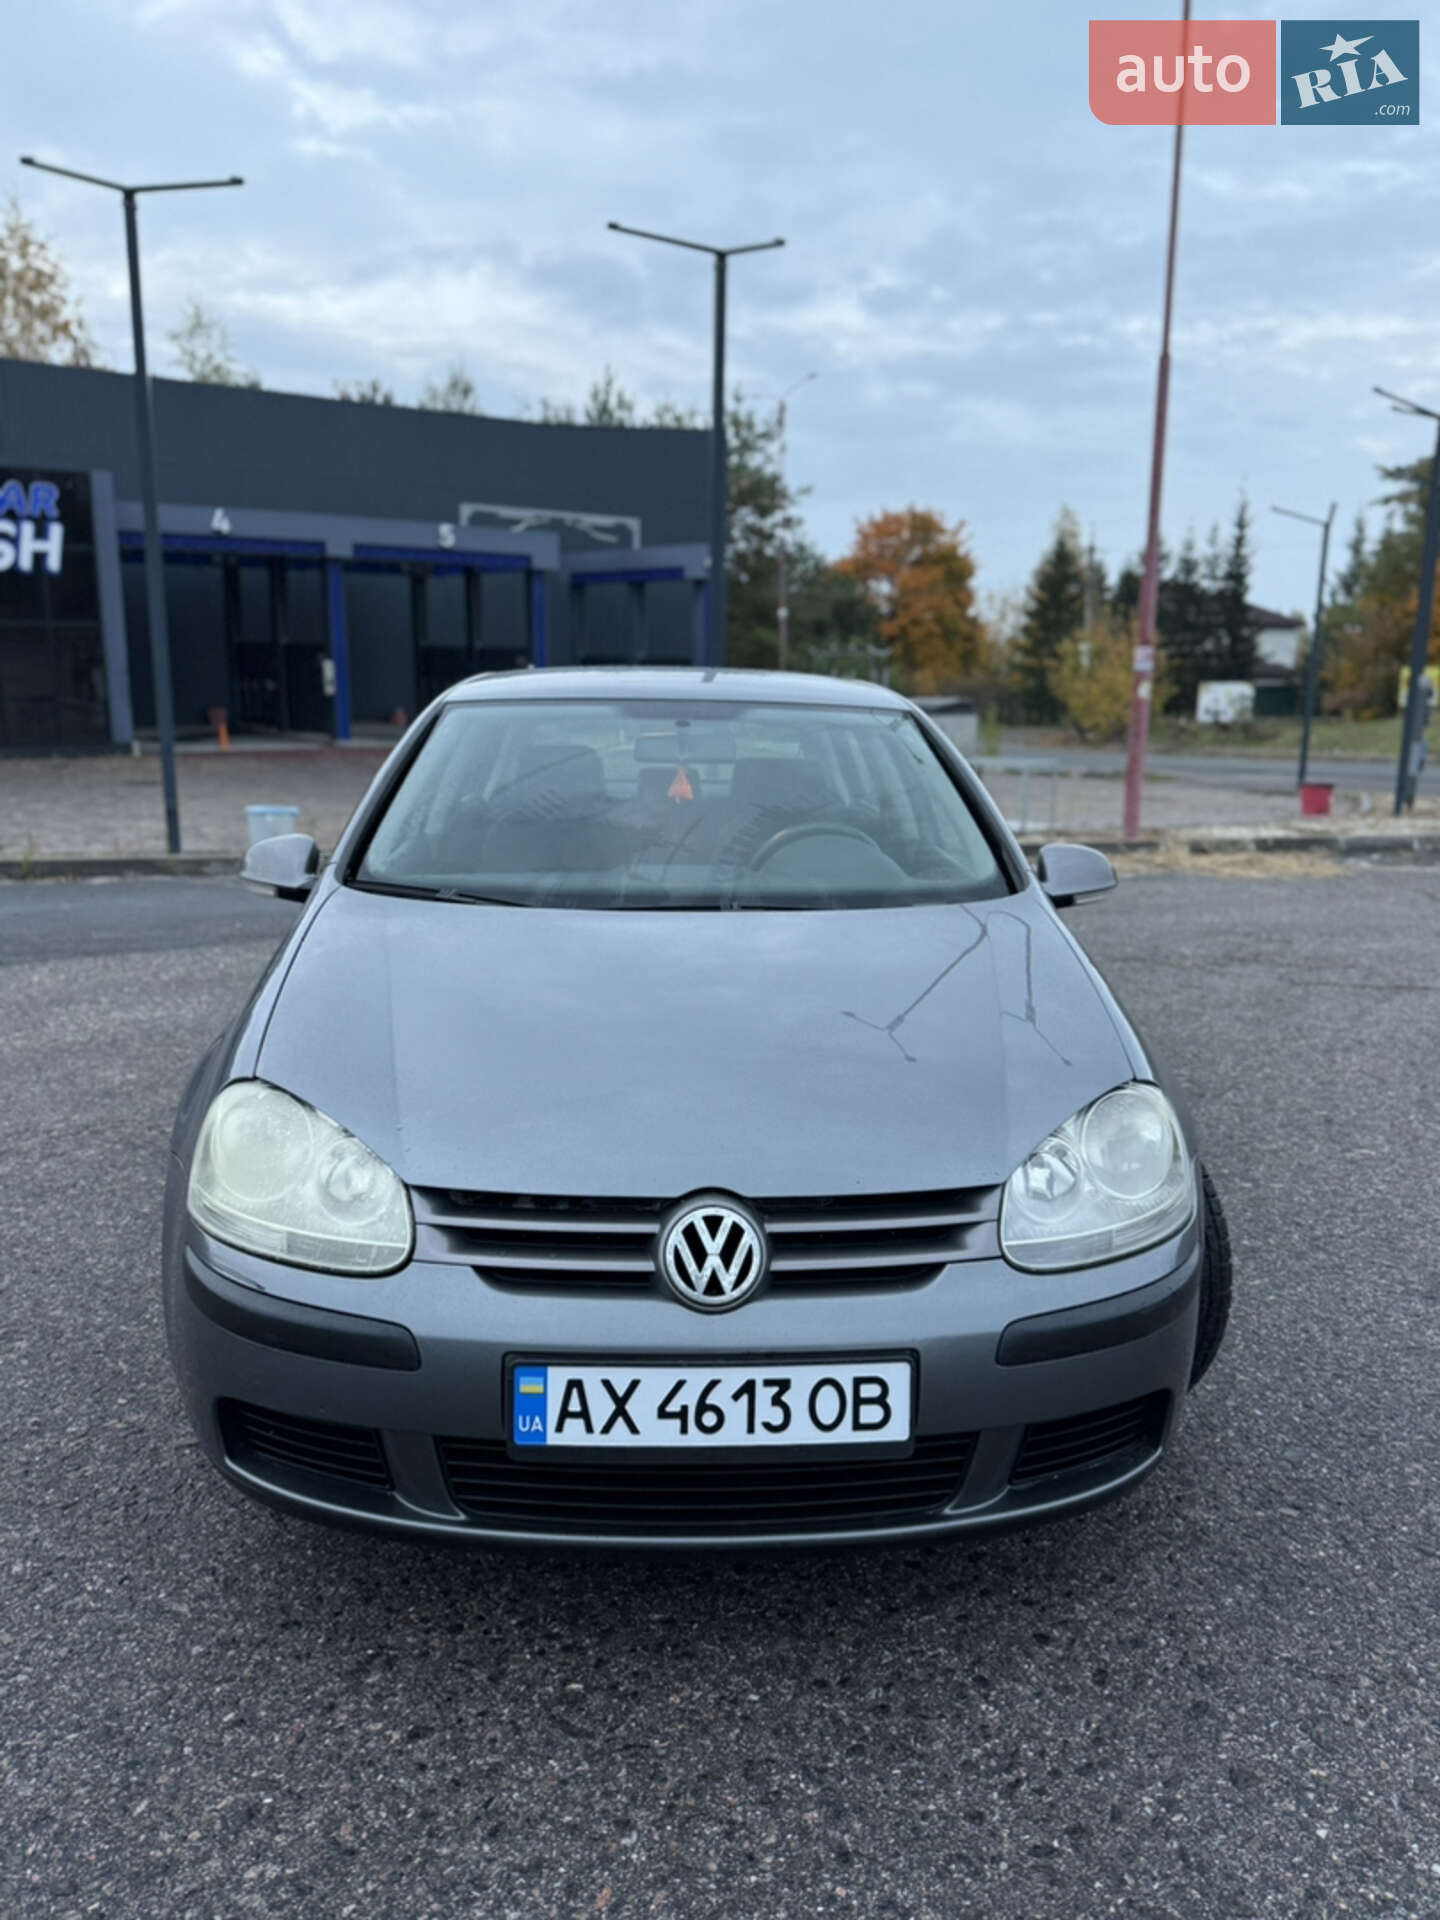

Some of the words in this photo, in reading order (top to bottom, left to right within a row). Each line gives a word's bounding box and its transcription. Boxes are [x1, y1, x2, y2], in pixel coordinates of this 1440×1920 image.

[210, 507, 232, 534] 4
[438, 522, 456, 548] 5
[554, 1378, 641, 1435] AX
[656, 1378, 792, 1435] 4613
[808, 1375, 892, 1433] OB
[518, 1415, 544, 1433] UA
